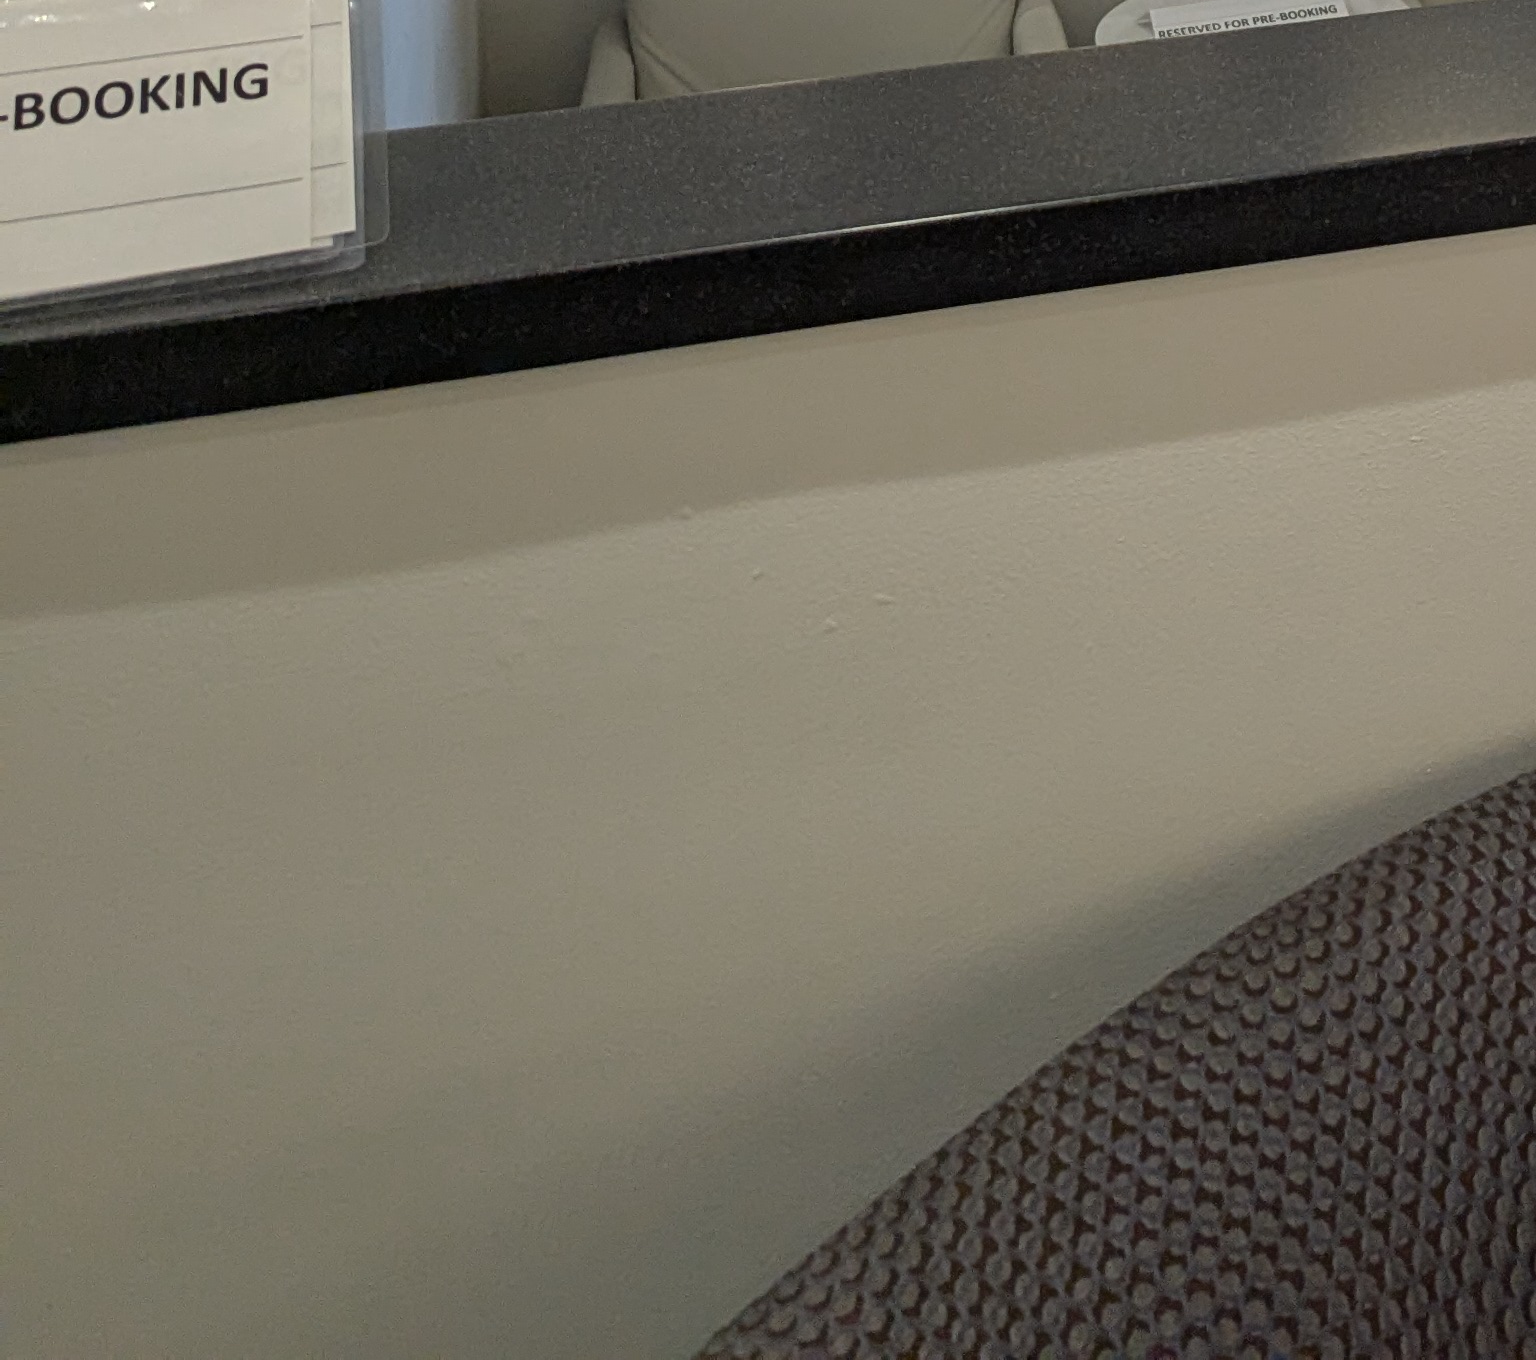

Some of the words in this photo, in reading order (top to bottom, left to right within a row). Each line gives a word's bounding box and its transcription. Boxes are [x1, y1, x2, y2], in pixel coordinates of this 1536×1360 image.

[1158, 23, 1221, 37] RESERVED
[1224, 18, 1250, 29] FOR
[1252, 4, 1338, 25] PRE-BOOKING
